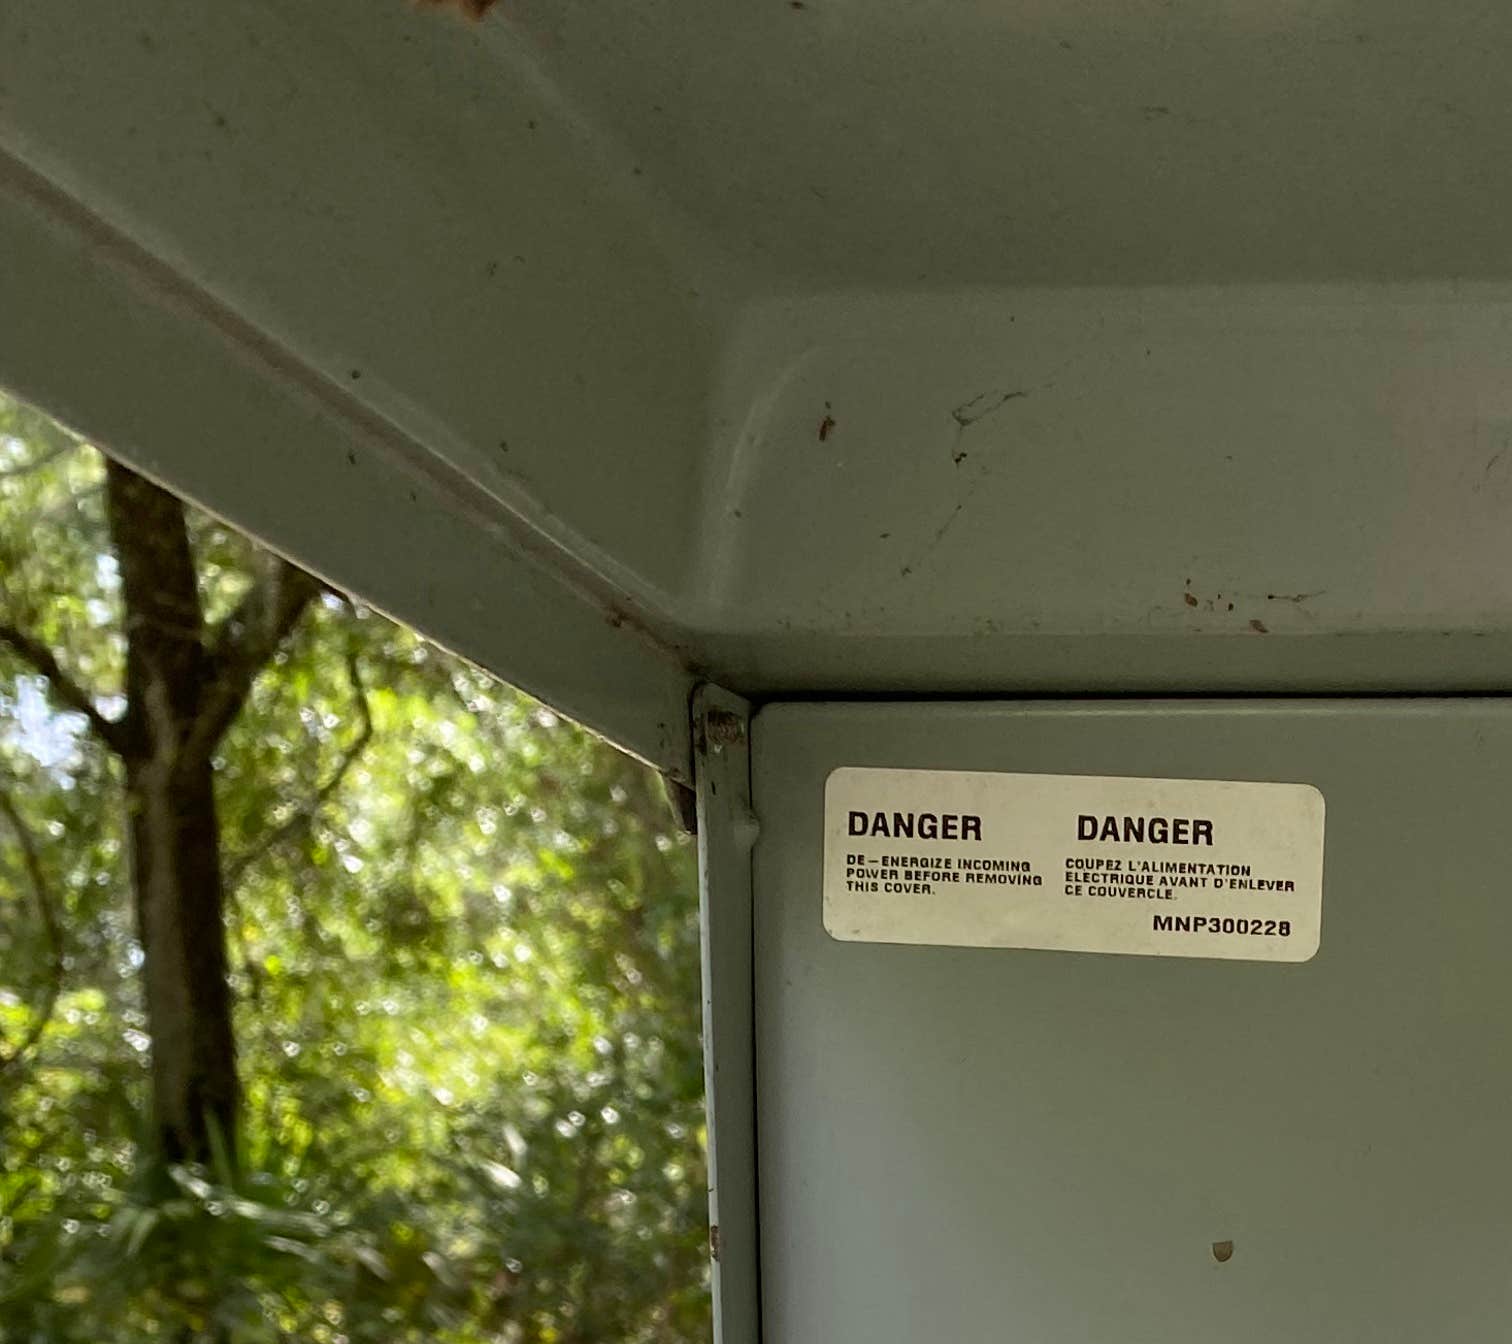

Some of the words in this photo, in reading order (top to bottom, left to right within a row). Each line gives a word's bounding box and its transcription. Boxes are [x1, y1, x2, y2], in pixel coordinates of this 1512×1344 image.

[848, 811, 982, 841] DANGER
[1078, 815, 1213, 846] DANGER
[958, 858, 1030, 872] INCOMING
[1065, 858, 1122, 871] COUPEZ
[1128, 860, 1250, 876] L'ALIMENTATION
[846, 868, 899, 880] POWER
[904, 870, 960, 882] BEFORE
[966, 872, 1042, 886] REMOVING
[1159, 876, 1208, 888] AVANT
[846, 881, 878, 892] THIS
[884, 882, 935, 895] COVER.
[1065, 885, 1082, 896] CE
[1088, 885, 1178, 900] COUVERCLE.
[1153, 915, 1290, 937] MNP300228
